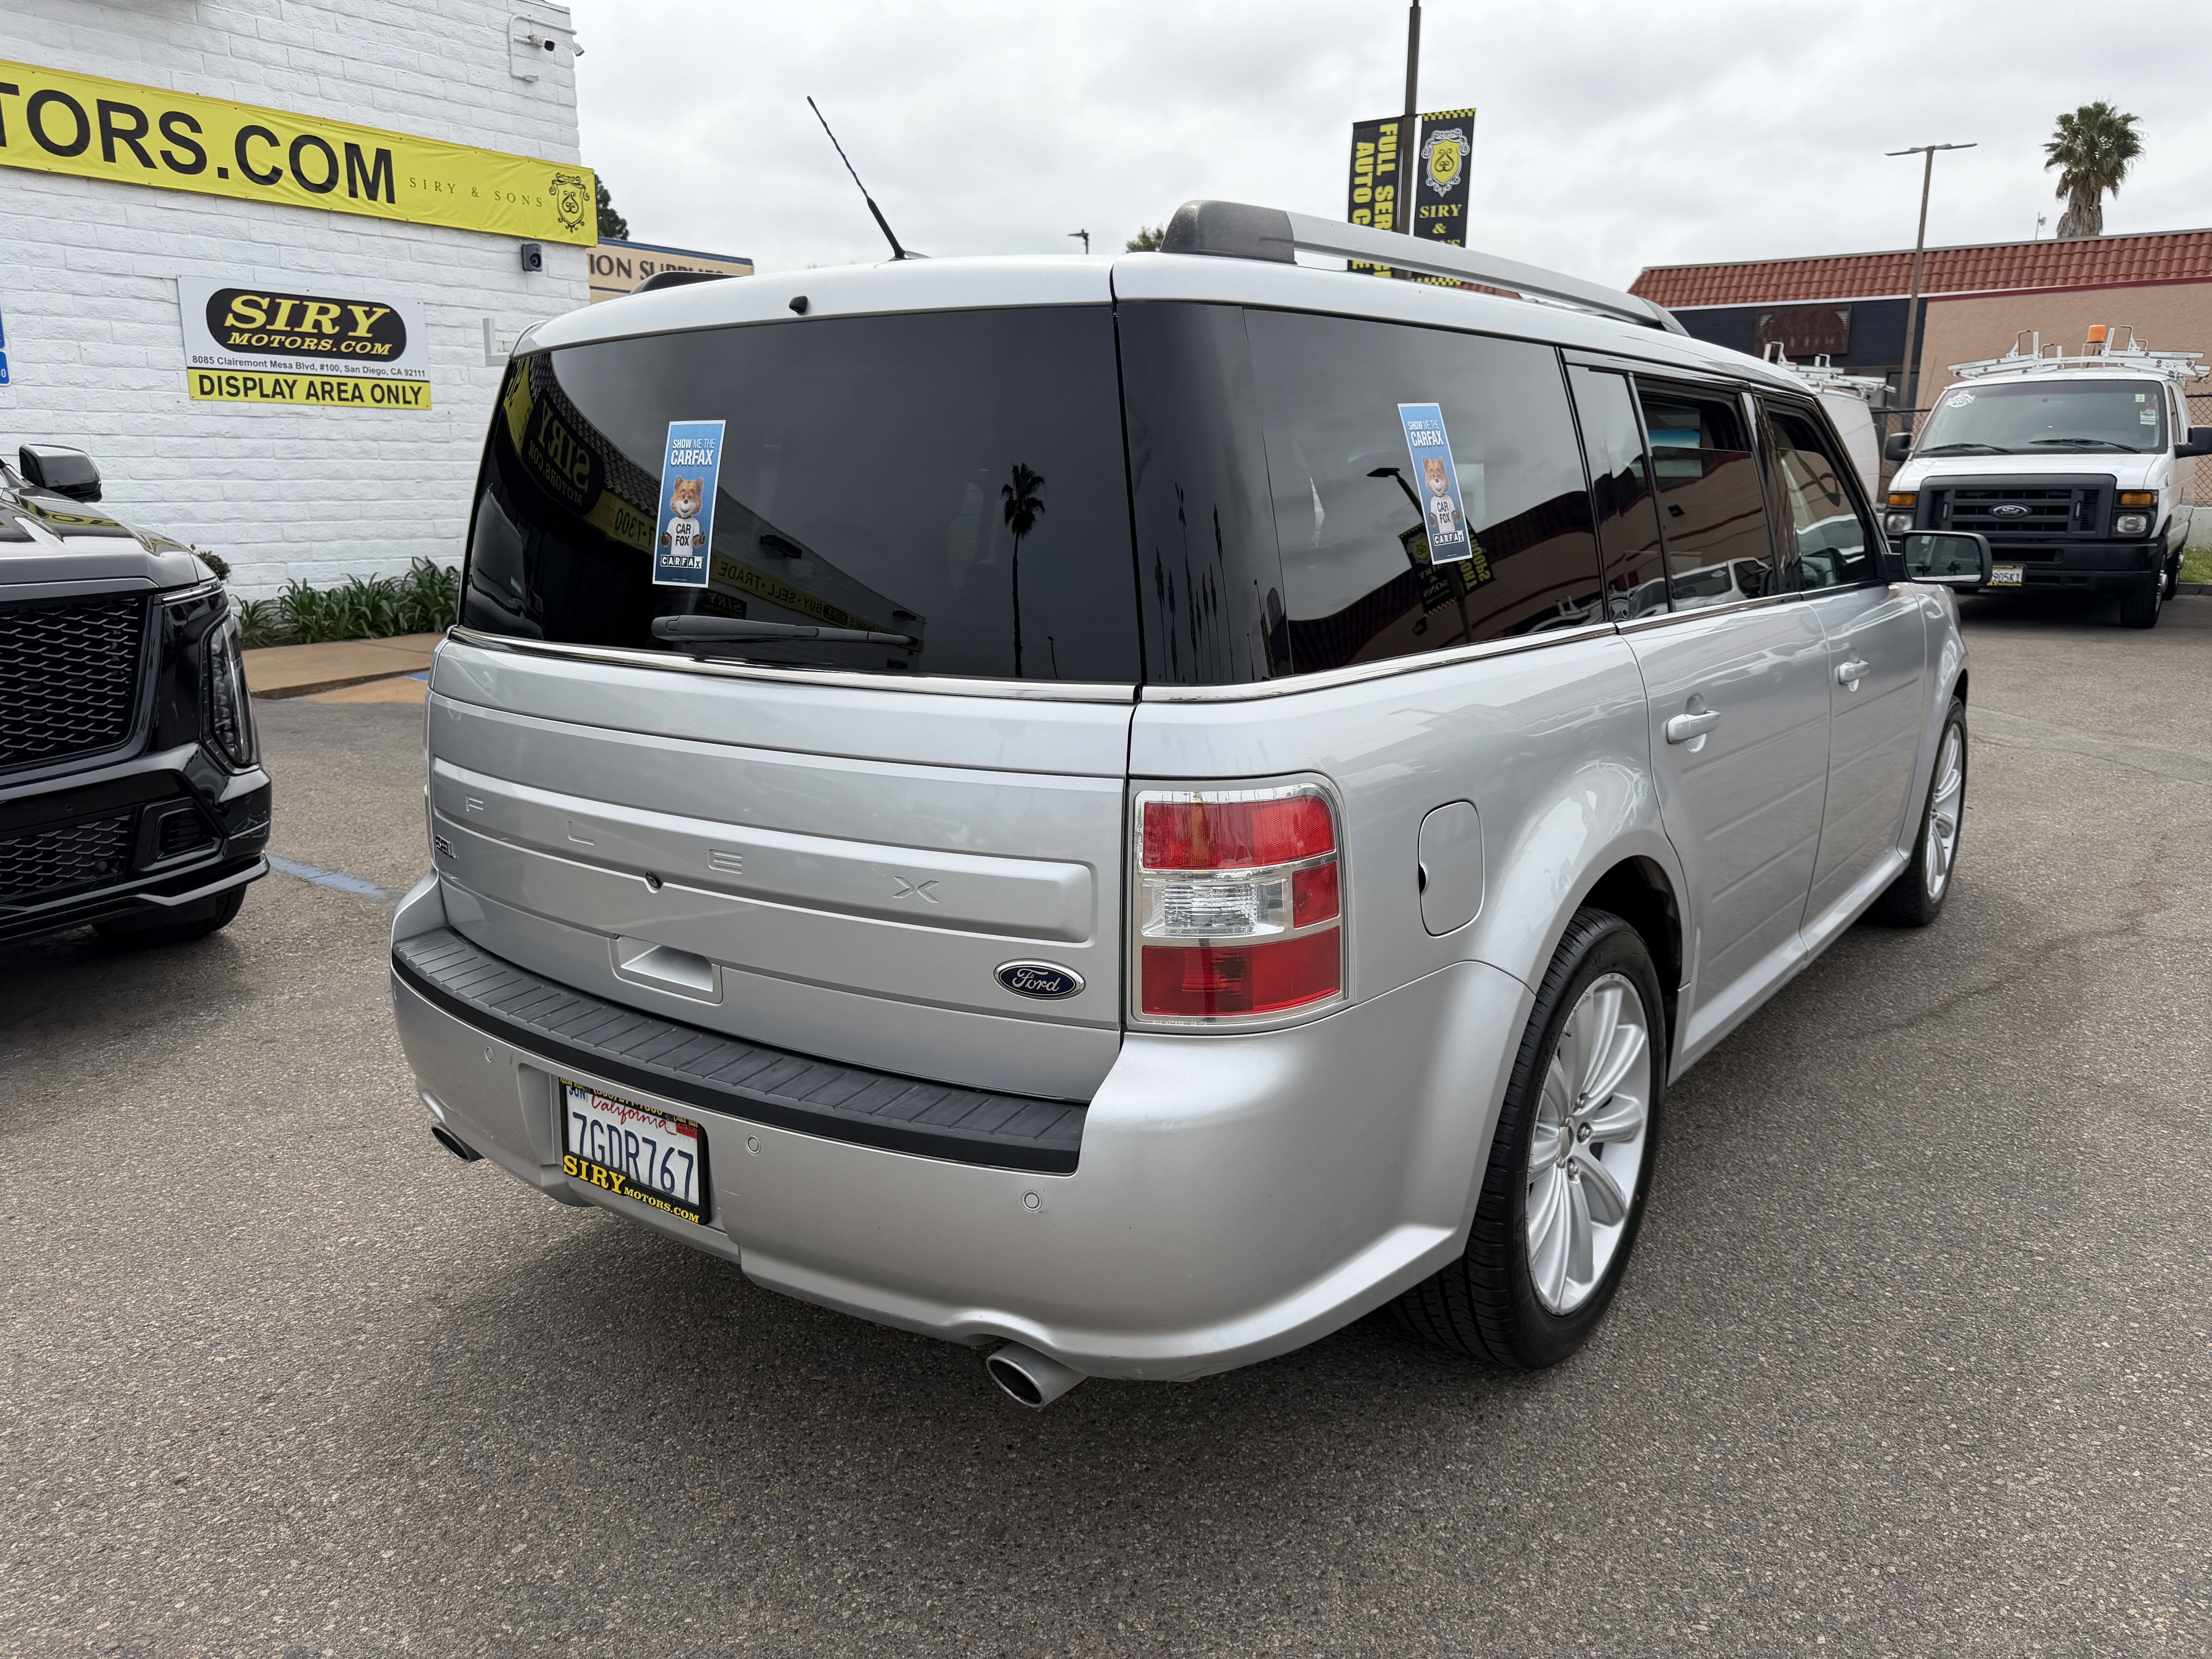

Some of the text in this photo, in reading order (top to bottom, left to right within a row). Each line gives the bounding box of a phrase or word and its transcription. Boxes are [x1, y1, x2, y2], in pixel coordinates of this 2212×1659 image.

[1376, 123, 1398, 176] FULL
[1353, 142, 1375, 204] AUTO
[410, 177, 543, 207] SIRY & SONS
[1419, 204, 1462, 219] SIRY
[1432, 223, 1447, 235] &
[587, 254, 632, 279] ION
[224, 295, 390, 337] SIRY
[227, 332, 392, 355] MOTORS.COM
[192, 356, 215, 365] 8085
[217, 357, 267, 368] Clairemont
[270, 360, 293, 369] Mesa
[297, 362, 318, 372] Blvd,
[320, 364, 342, 373] #100,
[345, 365, 361, 374] San
[363, 366, 388, 376] Diego,
[198, 374, 422, 405] DISPLAY AREA ONLY
[1407, 420, 1440, 431] SHOW ME THE
[673, 438, 716, 449] SHOW ME THE
[1411, 430, 1444, 447] CARFAX
[671, 450, 714, 466] CARFAX
[1437, 501, 1449, 513] CAR
[1439, 512, 1451, 524] FOX
[676, 523, 691, 535] CAR
[1433, 531, 1464, 545] CARFAX
[675, 535, 690, 546] FOX
[661, 555, 702, 568] CARFAX
[435, 835, 459, 860] SEL
[1012, 969, 1061, 991] Ford
[592, 1095, 677, 1135] California
[573, 1112, 694, 1202] 7GDR767
[563, 1155, 699, 1223] SIRY MOTORS.COM
